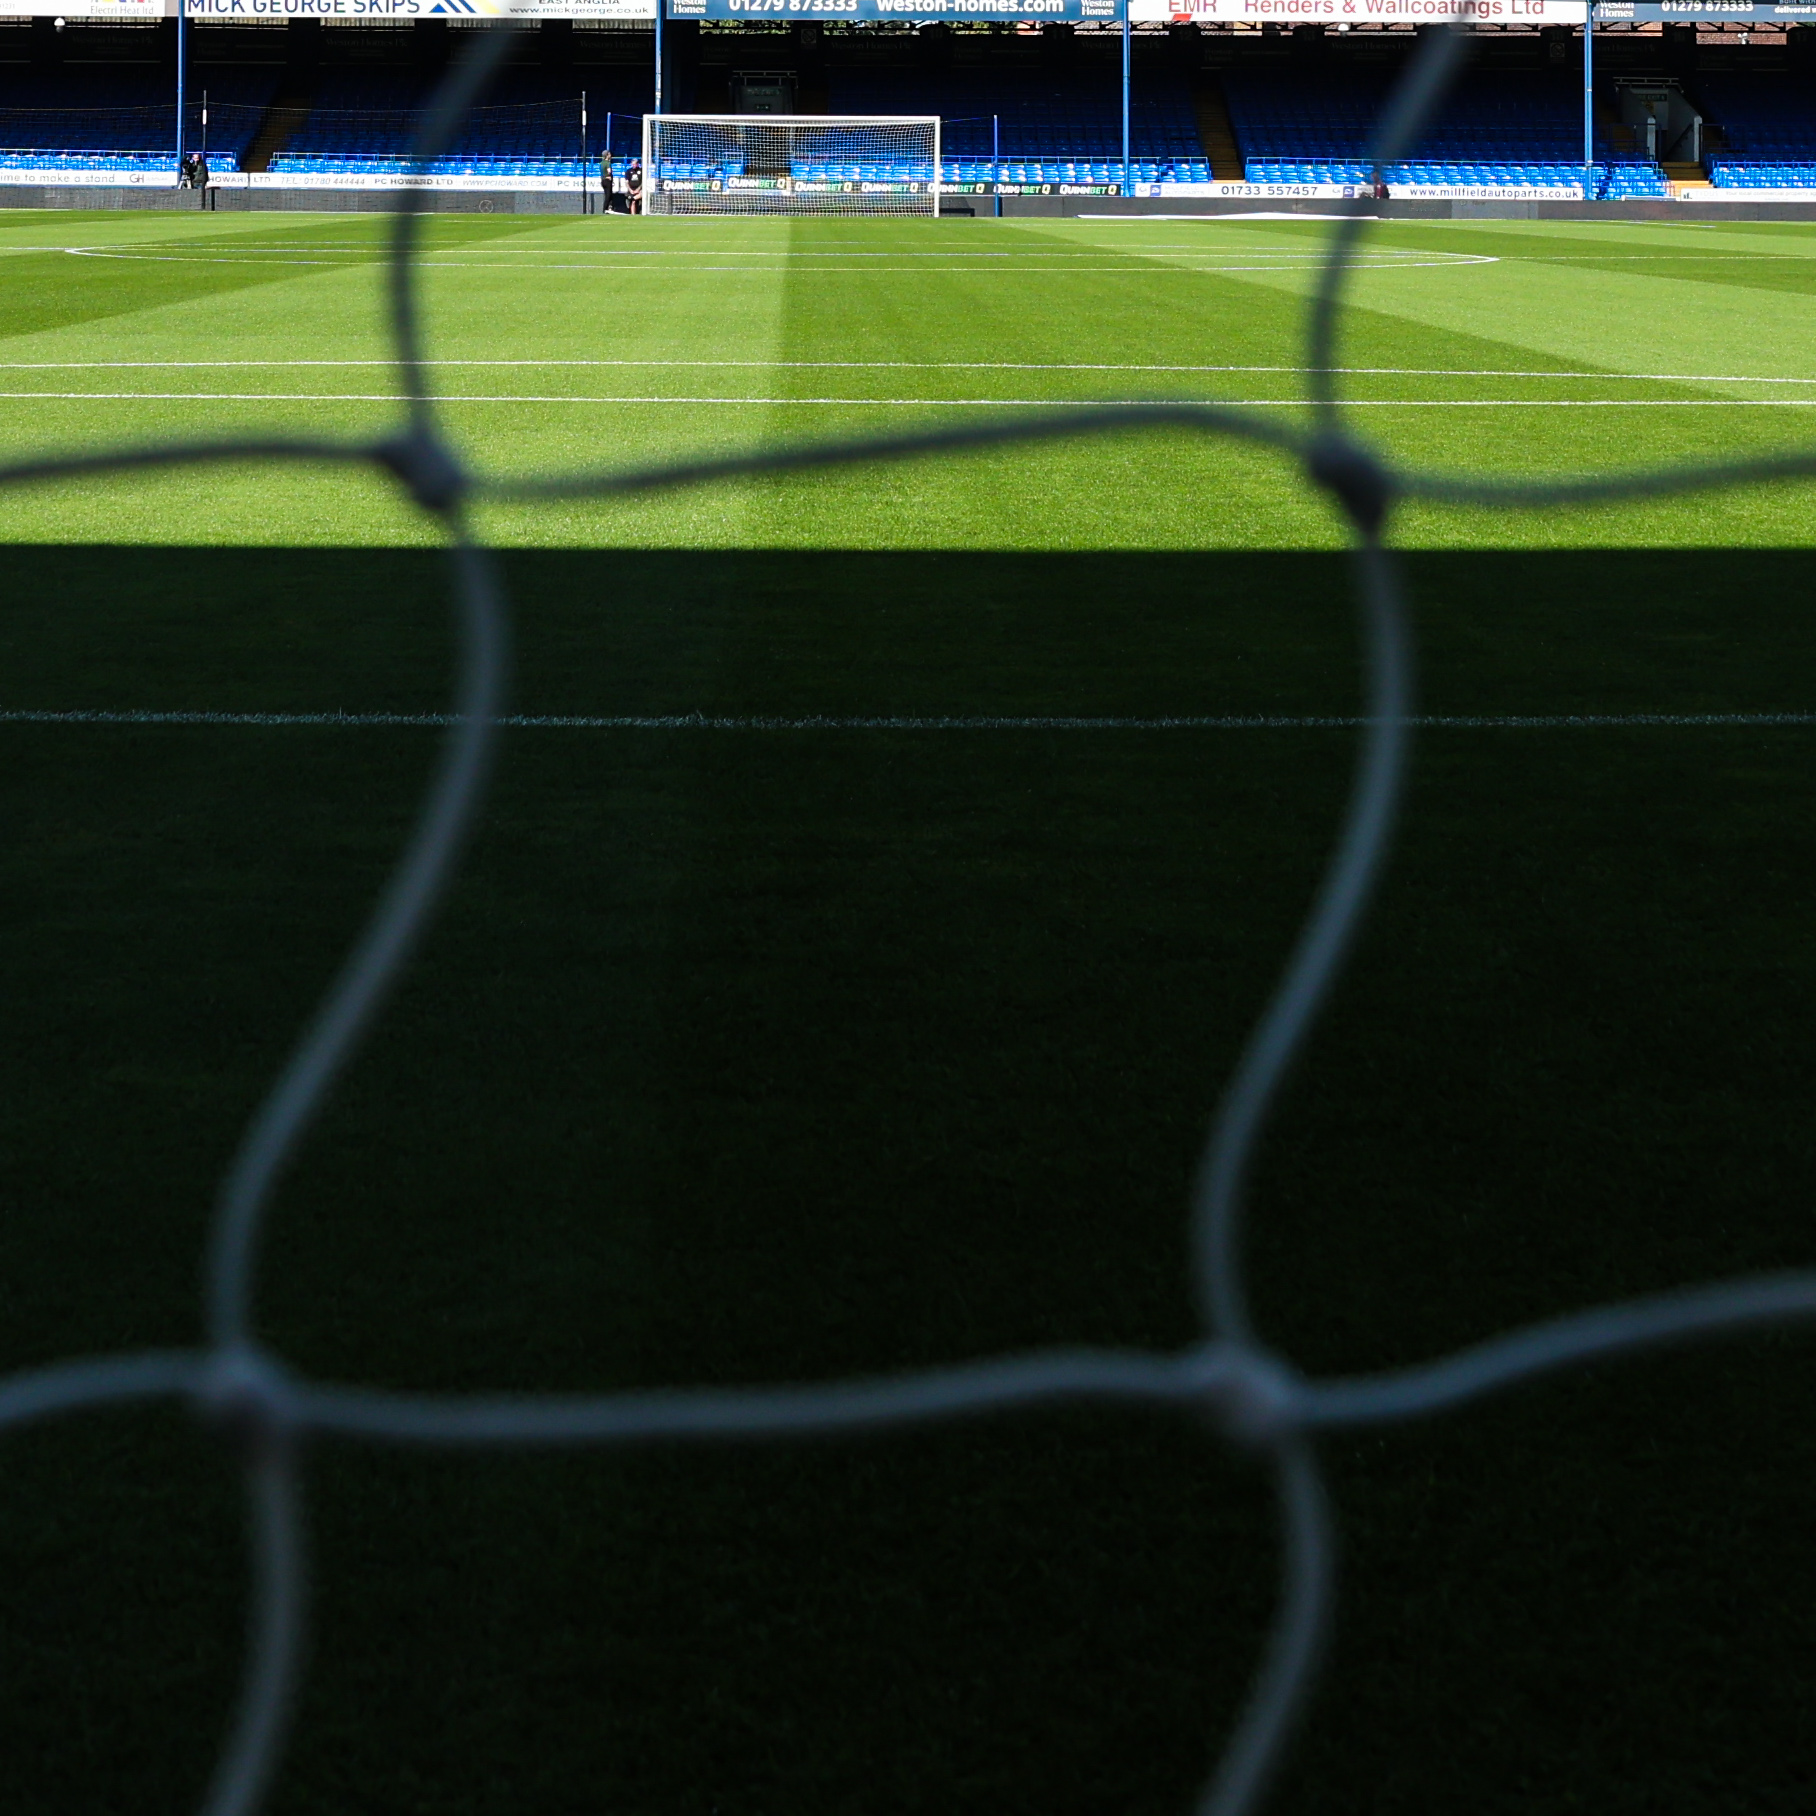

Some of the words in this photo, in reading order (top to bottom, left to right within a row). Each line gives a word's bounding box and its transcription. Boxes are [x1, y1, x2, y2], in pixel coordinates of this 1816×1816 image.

[1600, 0, 1634, 9] Weston
[1661, 0, 1702, 12] 01279
[1705, 0, 1754, 12] 873333
[90, 5, 118, 15] Electri
[120, 5, 140, 15] Heat
[509, 7, 649, 15] www.mickgeorge.co.uk
[673, 5, 706, 14] Homes
[1081, 7, 1114, 15] Homes
[1600, 9, 1634, 18] Homes
[1774, 6, 1811, 14] delivered
[24, 173, 36, 182] to
[39, 173, 70, 182] make
[83, 173, 115, 183] stand
[253, 176, 271, 184] LTD
[304, 177, 331, 185] 01780
[1060, 184, 1107, 195] QUINNBET
[1221, 185, 1261, 196] 01733
[1267, 186, 1318, 196] 557457
[1410, 187, 1579, 199] www.millfieldautoparts.co.uk
